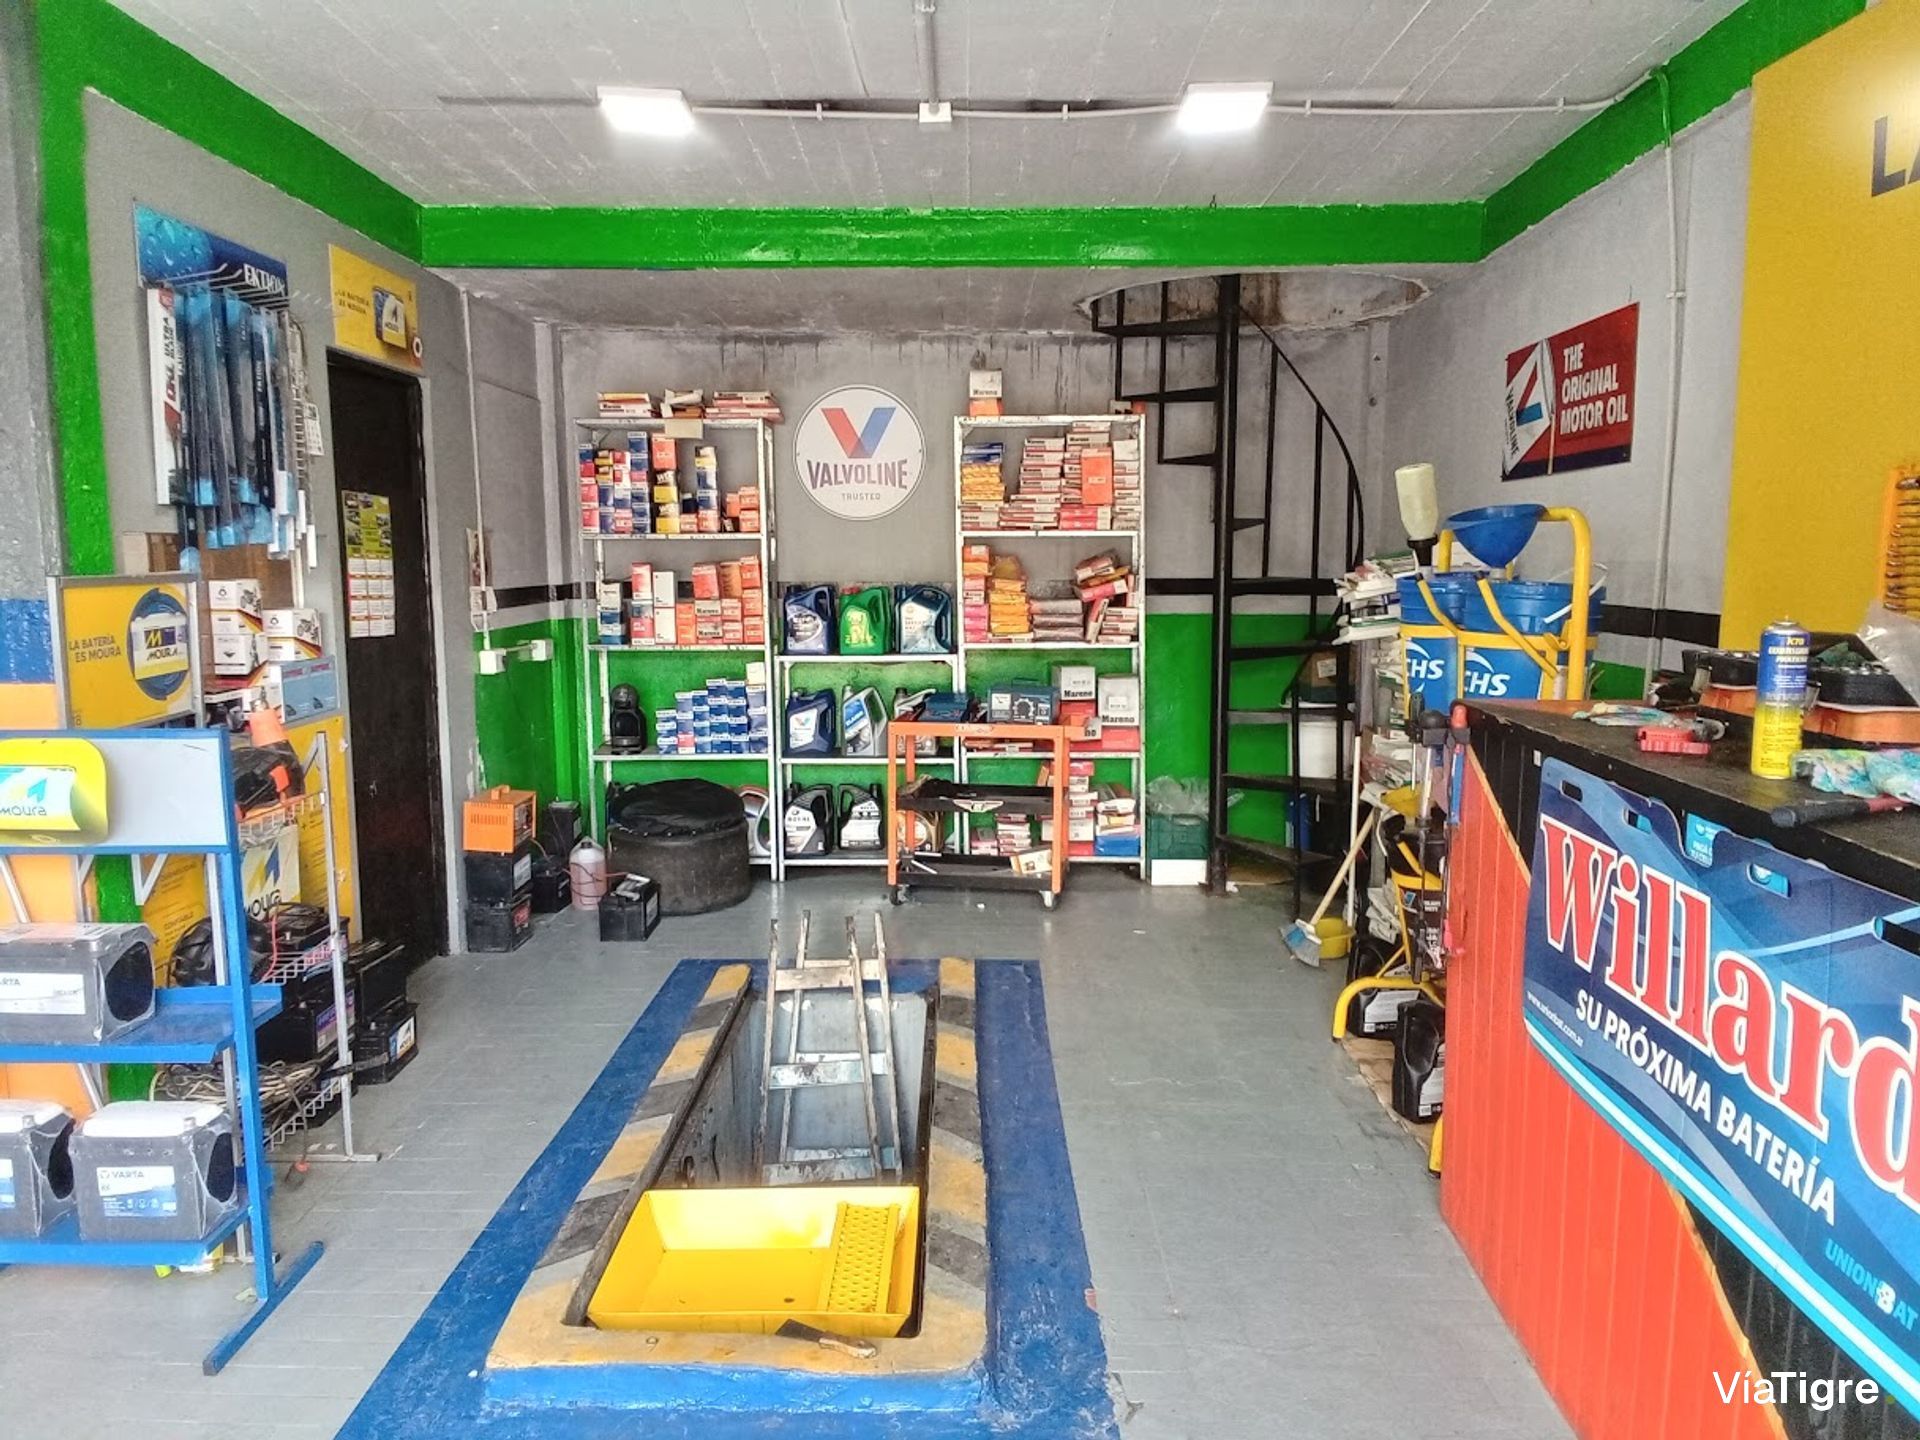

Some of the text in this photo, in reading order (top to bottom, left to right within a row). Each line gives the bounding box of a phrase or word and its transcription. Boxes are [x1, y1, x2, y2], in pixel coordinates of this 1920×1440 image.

[1871, 116, 1920, 197] L
[1563, 342, 1585, 373] THE
[1562, 364, 1618, 404] ORIGINAL
[1505, 385, 1520, 455] VALVOLINE
[1560, 394, 1629, 435] MOTOR OIL
[806, 458, 909, 491] VALVOLINE
[841, 492, 881, 501] TRUSTED
[69, 633, 115, 651] LA BATERÍA
[75, 646, 122, 663] ES MOURA
[146, 648, 178, 661] MOURA
[1102, 715, 1135, 723] Mareno
[1539, 814, 1920, 1216] Willard
[1575, 988, 1836, 1227] SU PRÓXIMA BATERÍA
[112, 1170, 144, 1178] VARTA
[1824, 1237, 1919, 1331] UNIONBAT
